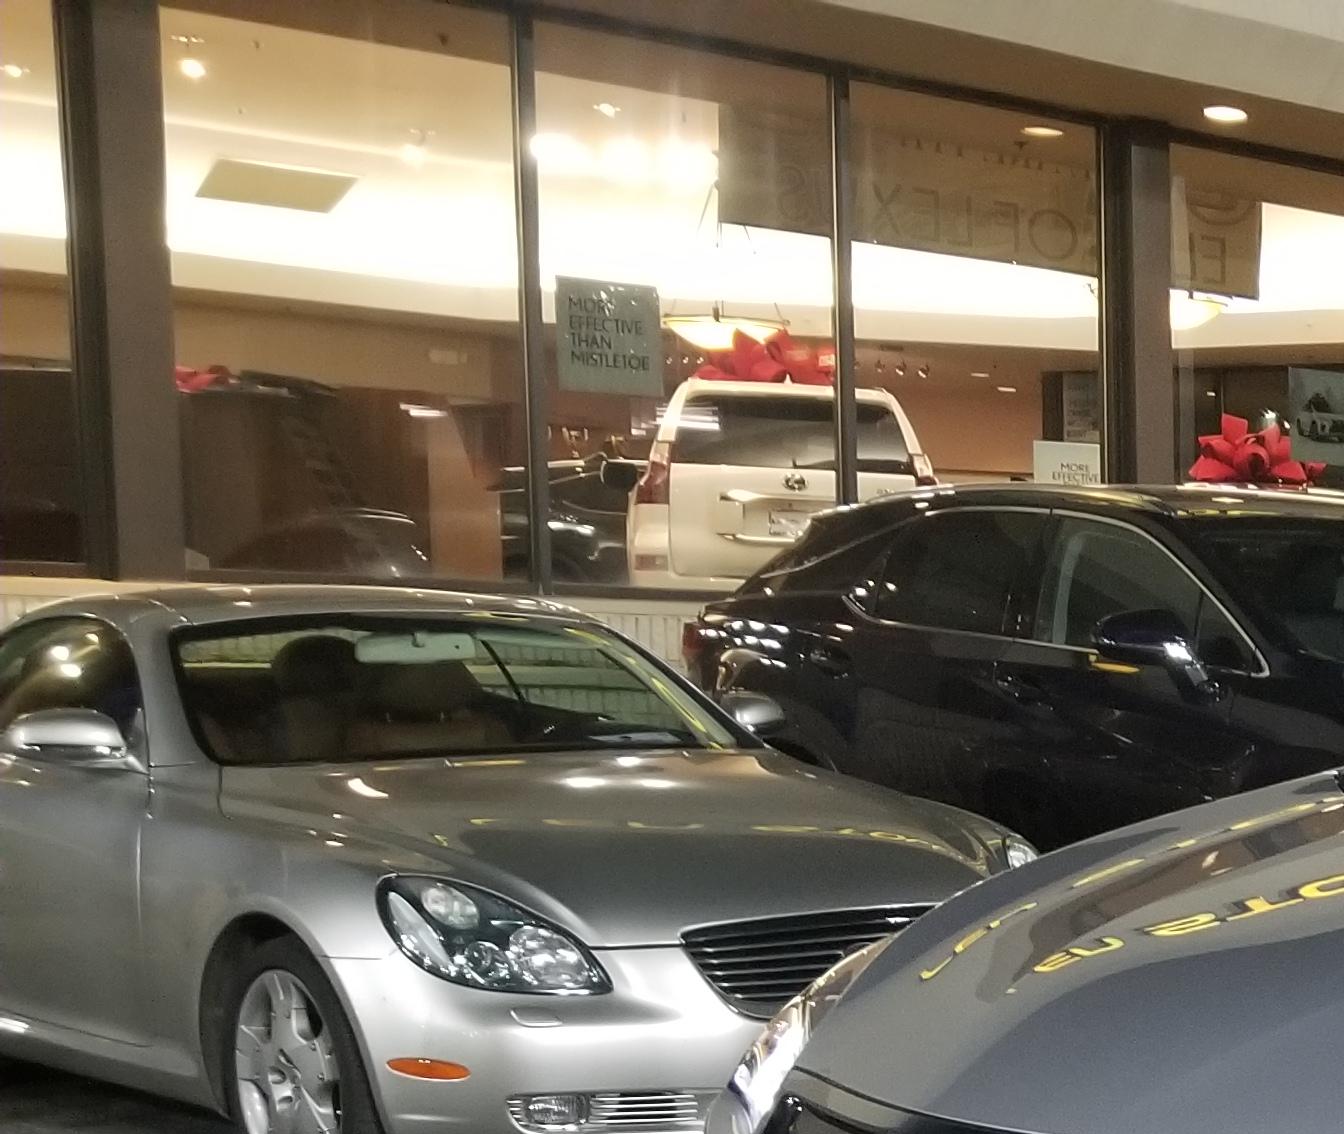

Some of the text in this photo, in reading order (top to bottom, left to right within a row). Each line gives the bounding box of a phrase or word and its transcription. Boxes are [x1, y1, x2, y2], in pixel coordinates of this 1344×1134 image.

[568, 296, 615, 314] MOR
[570, 332, 612, 350] THAN
[570, 350, 650, 371] MISTLETOE
[1060, 461, 1089, 473] MORE
